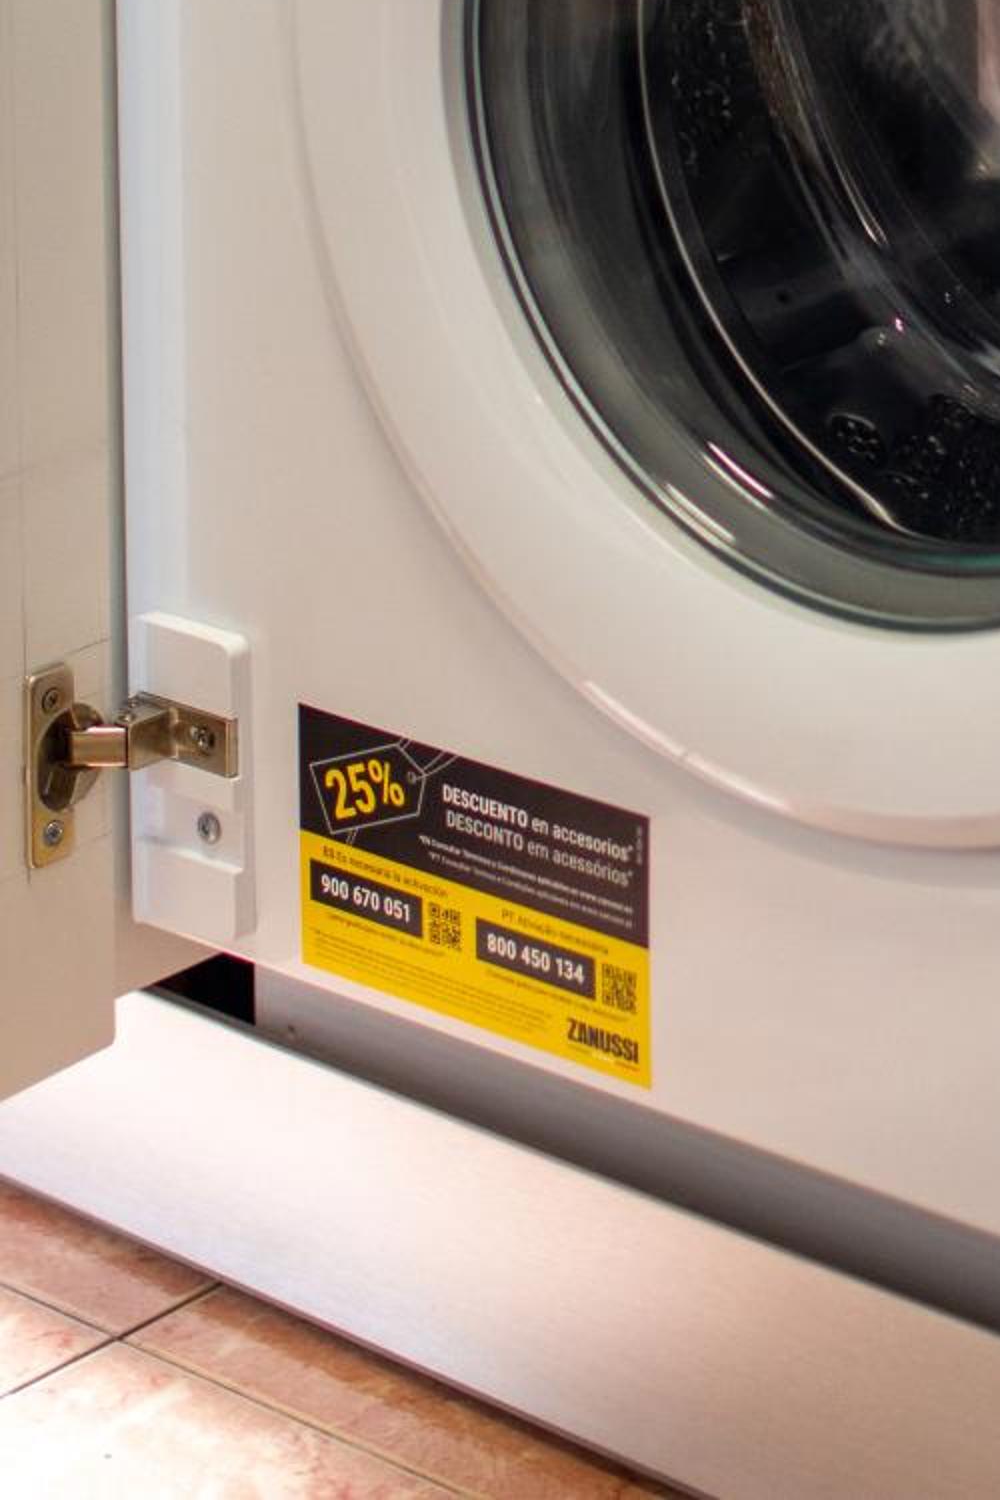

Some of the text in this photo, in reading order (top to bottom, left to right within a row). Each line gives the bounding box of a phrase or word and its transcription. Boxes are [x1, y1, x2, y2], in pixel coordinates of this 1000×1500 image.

[324, 758, 406, 821] 25%
[442, 783, 528, 829] DESCUENTO
[531, 817, 550, 836] en
[445, 809, 524, 851] DESCONTO
[526, 840, 550, 860] em
[320, 873, 411, 924] 900 670 051
[486, 932, 585, 985] 800 450 134
[567, 1016, 640, 1065] ZANUSSI
